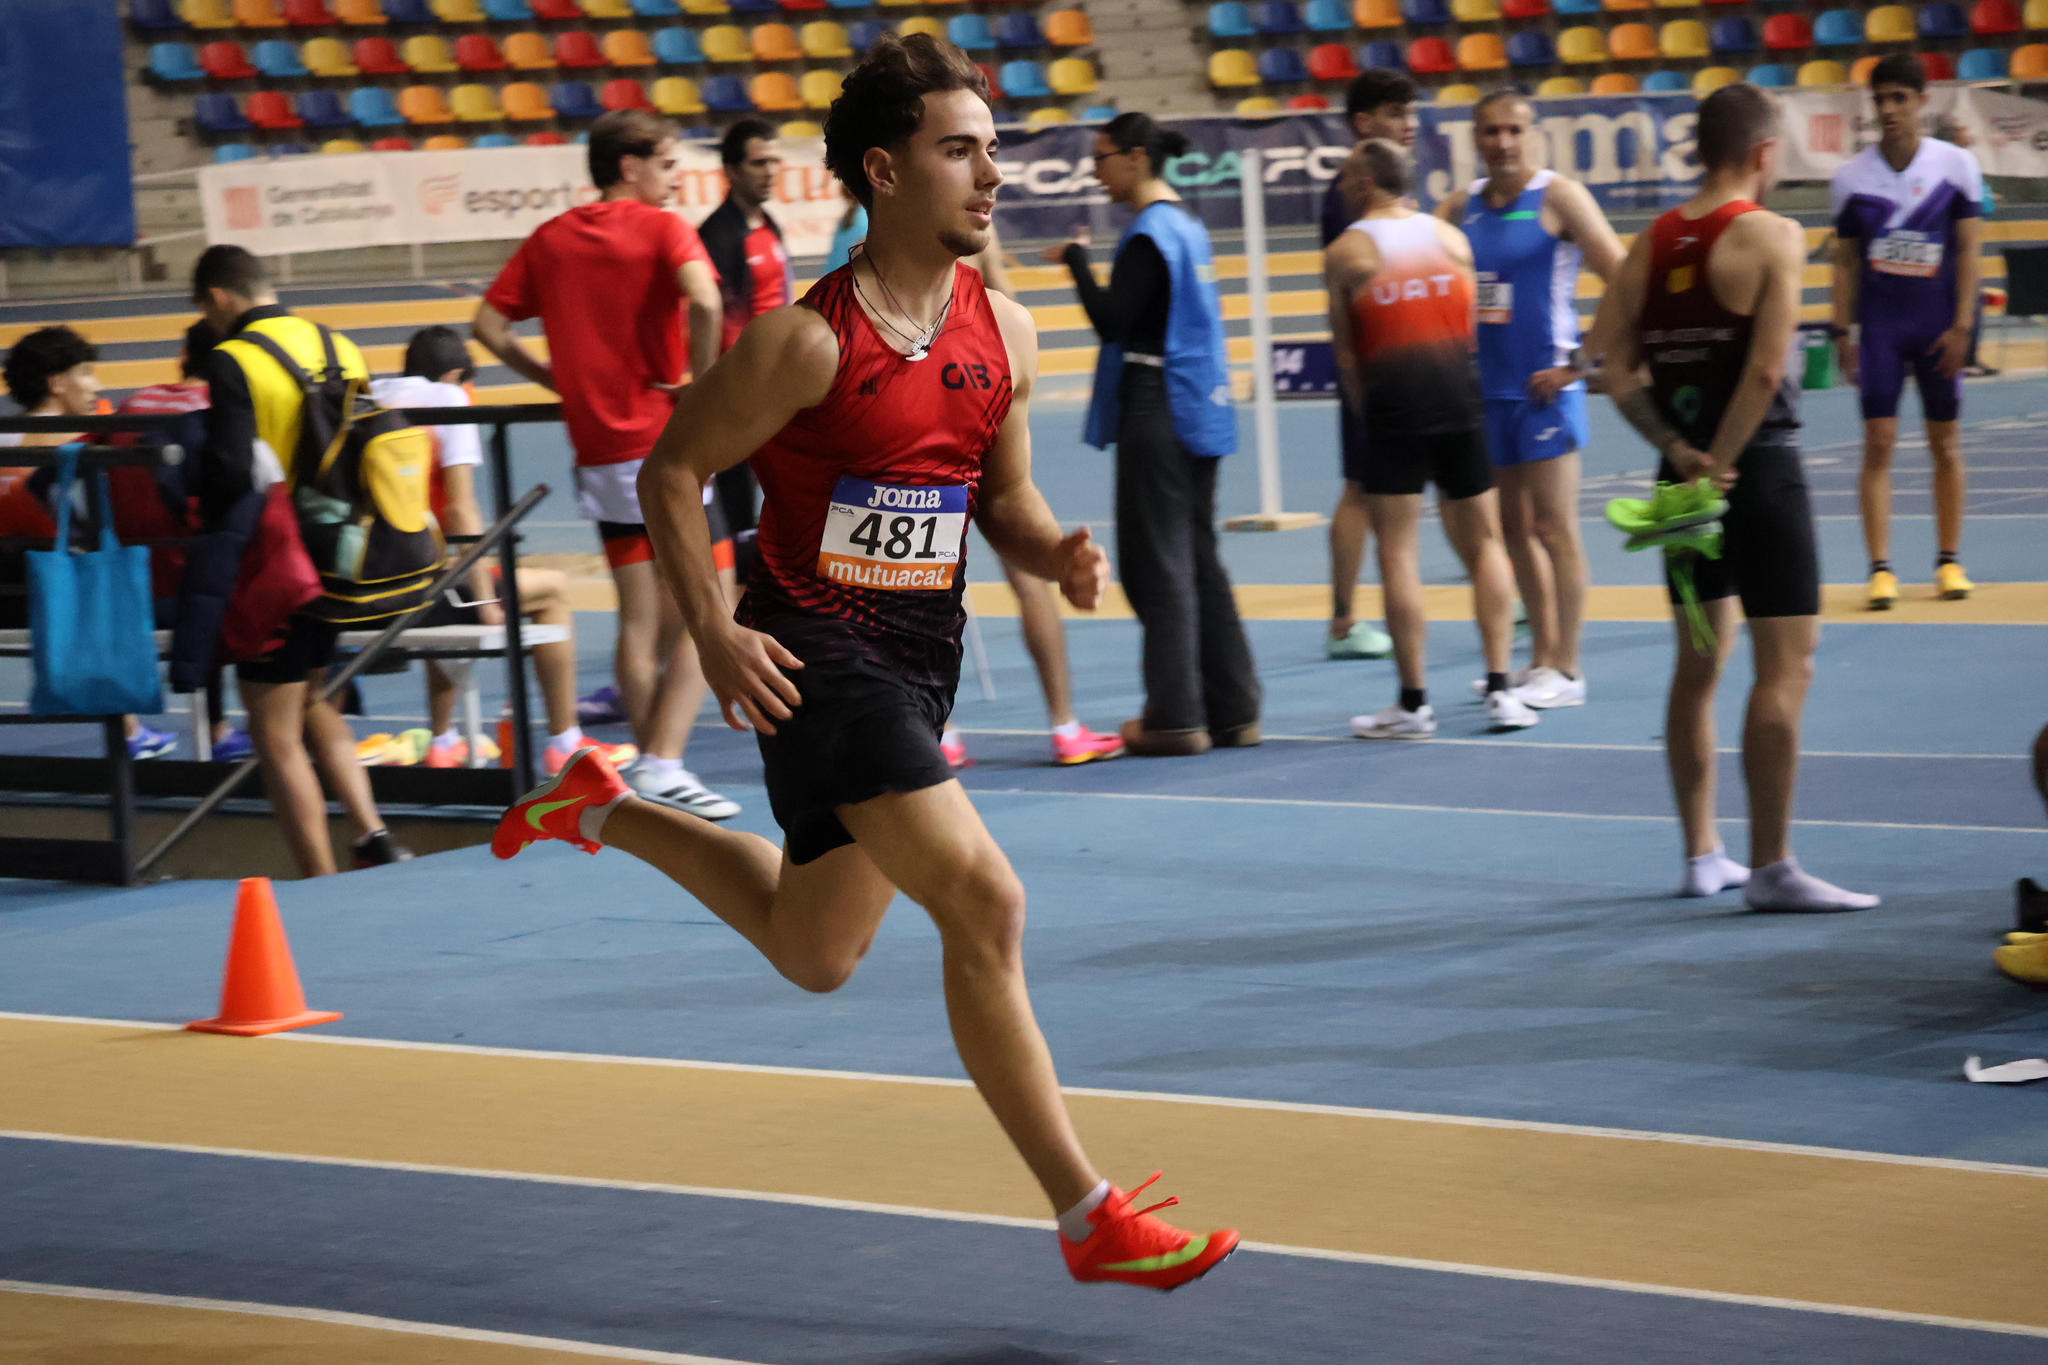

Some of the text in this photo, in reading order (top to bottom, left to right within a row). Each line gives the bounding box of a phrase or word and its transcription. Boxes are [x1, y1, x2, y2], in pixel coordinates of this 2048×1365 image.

[1373, 275, 1454, 305] UAT
[831, 505, 855, 516] FCA
[849, 512, 938, 560] 481
[828, 560, 946, 587] mutuacat
